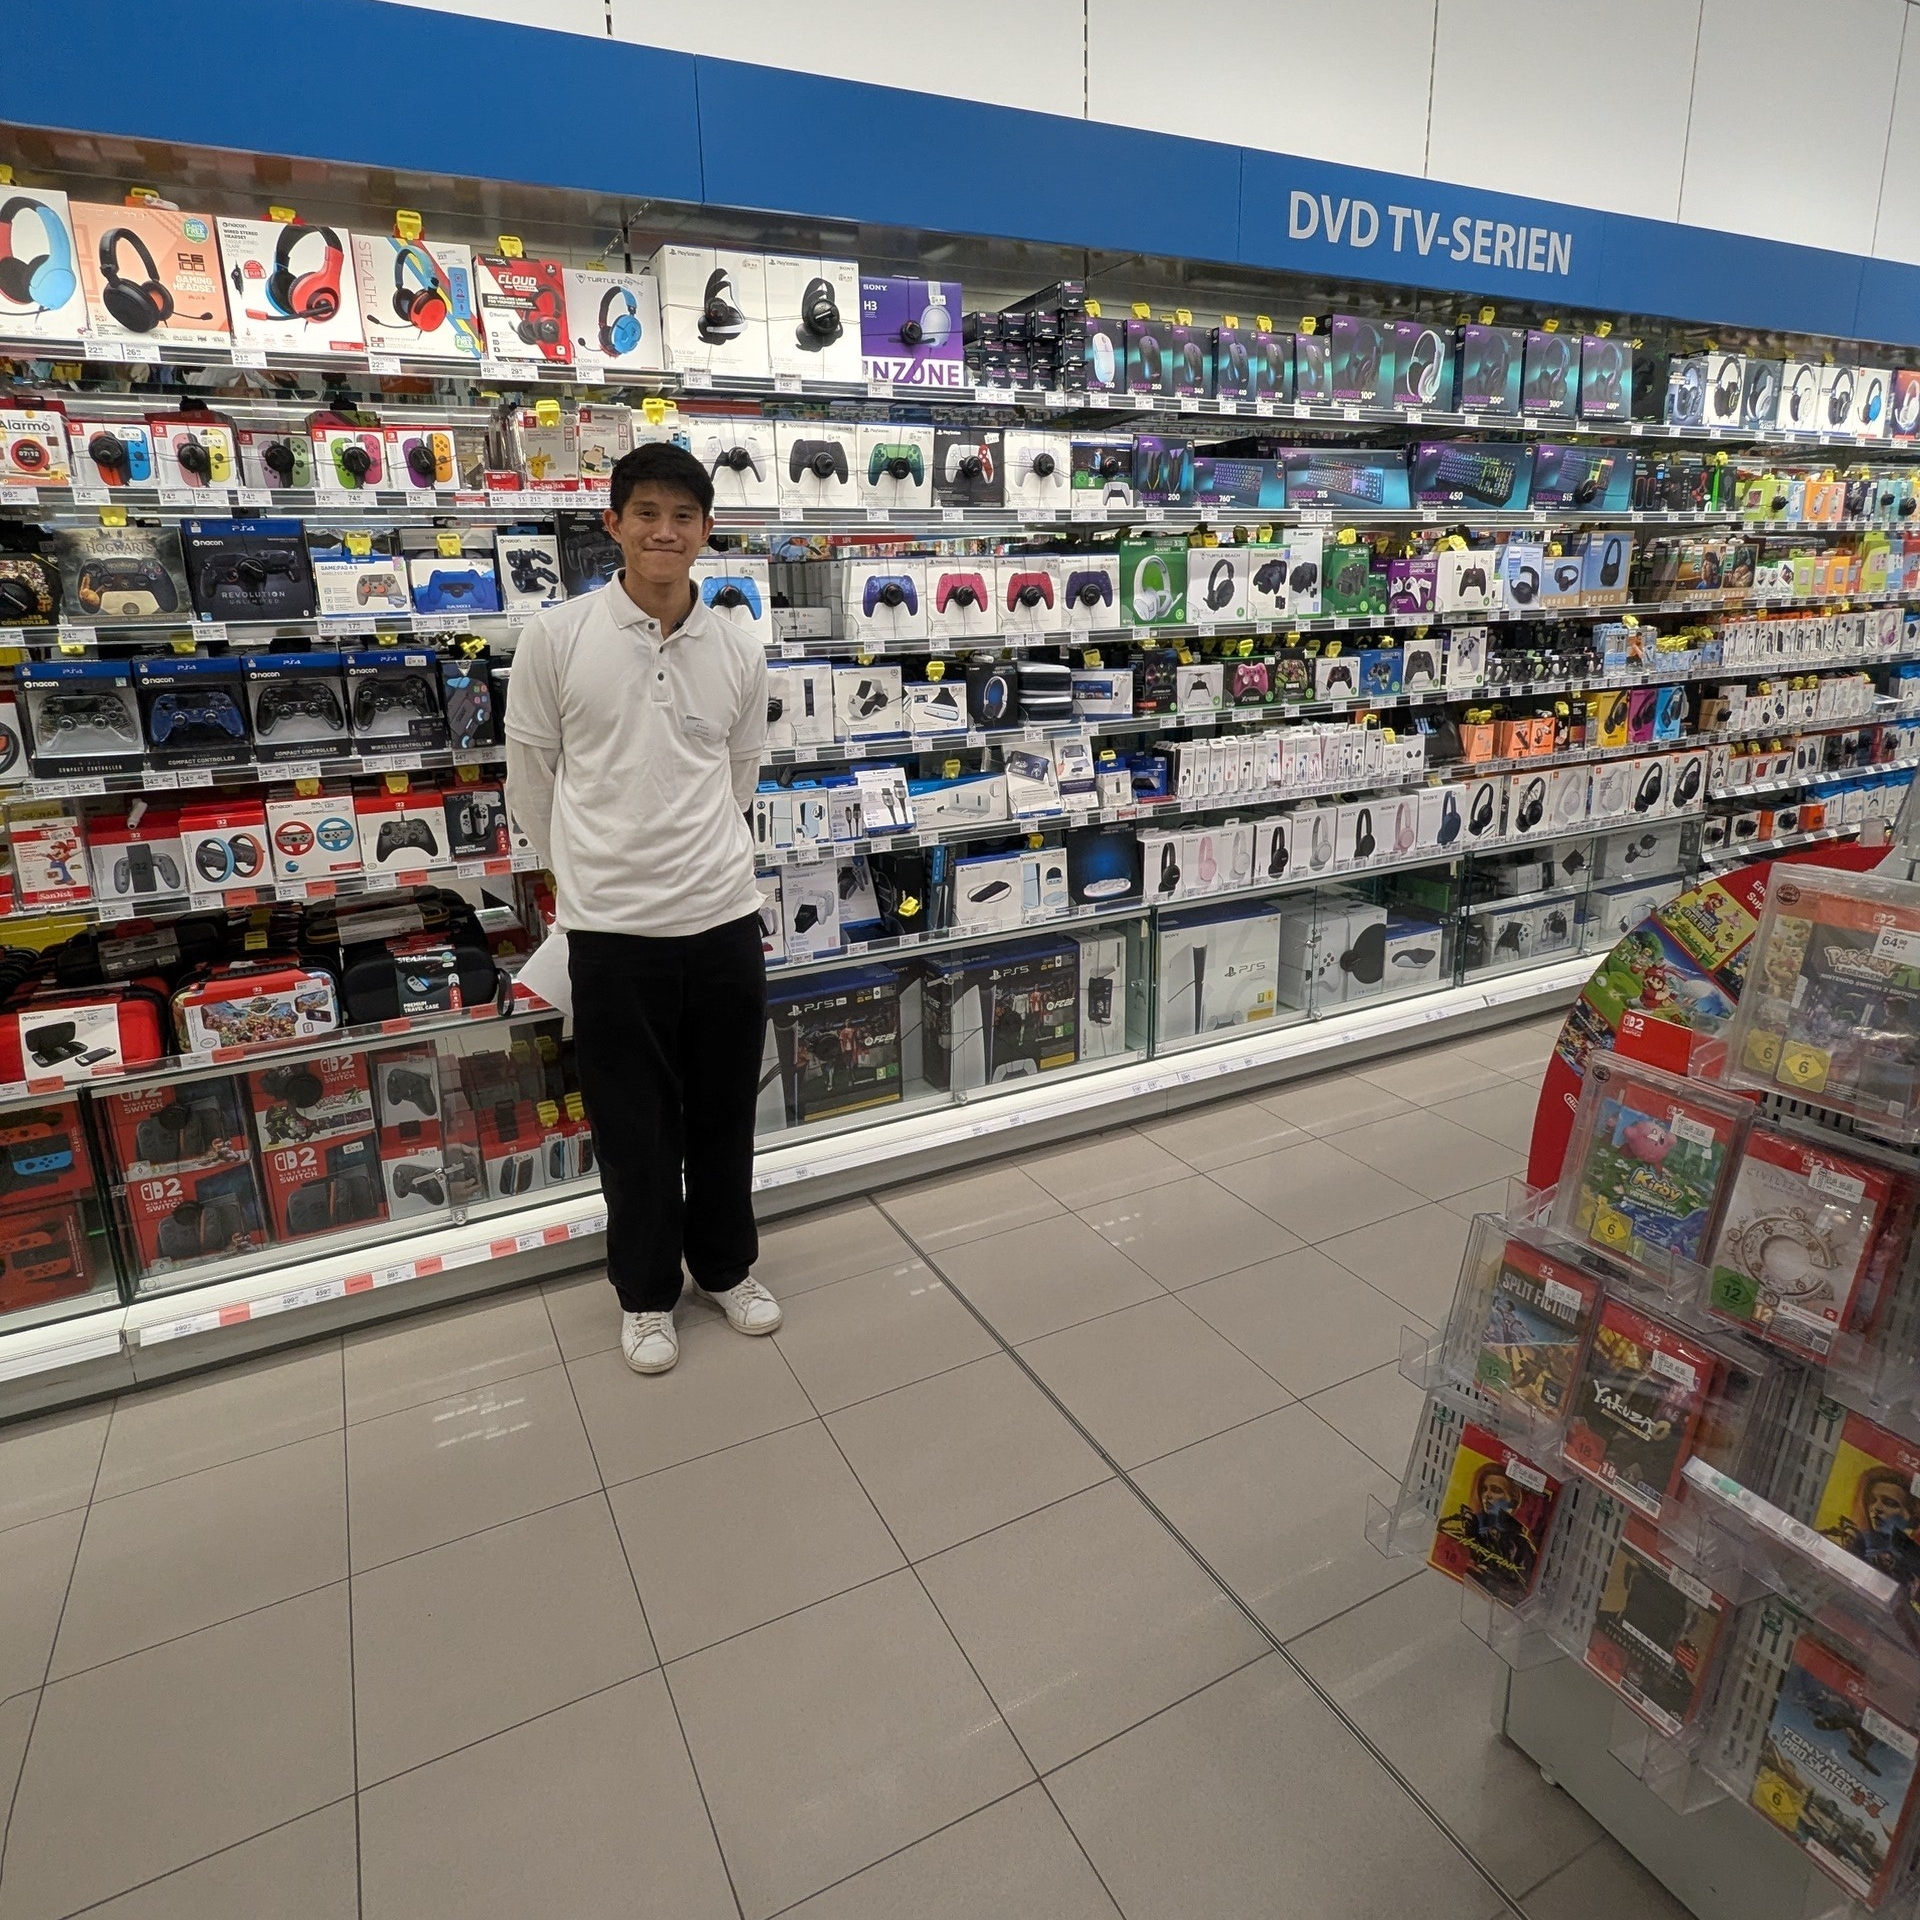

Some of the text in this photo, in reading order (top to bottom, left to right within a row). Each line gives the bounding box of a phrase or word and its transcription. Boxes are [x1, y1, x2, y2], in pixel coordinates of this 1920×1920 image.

[1289, 190, 1572, 275] DVD TV-SERIEN
[176, 276, 213, 287] GAMING
[498, 274, 538, 286] CLOUD
[587, 276, 614, 284] TURTLE
[173, 283, 217, 294] HEADSET
[863, 284, 888, 292] SONY
[864, 301, 878, 311] H3
[1449, 492, 1464, 501] 450
[232, 524, 256, 532] PS4
[86, 540, 155, 553] HOGWARTS
[222, 591, 286, 599] REVOLUTION
[302, 747, 338, 755] CONTROLLER
[195, 756, 236, 764] CONTROLLER
[1683, 907, 1715, 942] DELUXE
[1886, 915, 1897, 926] 2
[1003, 965, 1029, 977] PS5
[1239, 962, 1266, 976] PS5
[1836, 966, 1884, 983] LEGENDEN
[1821, 974, 1854, 985] NINTENDO
[1855, 980, 1882, 991] SWITCH
[1889, 988, 1918, 999] EDITION
[403, 1001, 427, 1009] PREMIUM
[804, 1000, 835, 1012] PS5
[1635, 1018, 1645, 1032] 2
[1763, 1047, 1774, 1059] 6
[342, 1054, 354, 1069] 2
[1799, 1060, 1809, 1074] 6
[324, 1072, 355, 1084] SWITCH
[124, 1102, 164, 1114] SWITCH
[299, 1148, 318, 1166] 2
[280, 1172, 319, 1184] SWITCH
[164, 1178, 183, 1196] 2
[1631, 1168, 1683, 1202] Kirby
[1607, 1224, 1616, 1235] 6
[1547, 1268, 1554, 1276] 2
[1502, 1272, 1534, 1300] SPLIT
[1725, 1284, 1741, 1301] 12
[1755, 1304, 1774, 1322] 12
[1654, 1336, 1661, 1346] 2
[1602, 1462, 1617, 1479] 18
[1782, 1725, 1826, 1762] TONY
[1781, 1736, 1807, 1763] PRO
[1805, 1753, 1850, 1798] SKATER
[1772, 1791, 1781, 1806] 6
